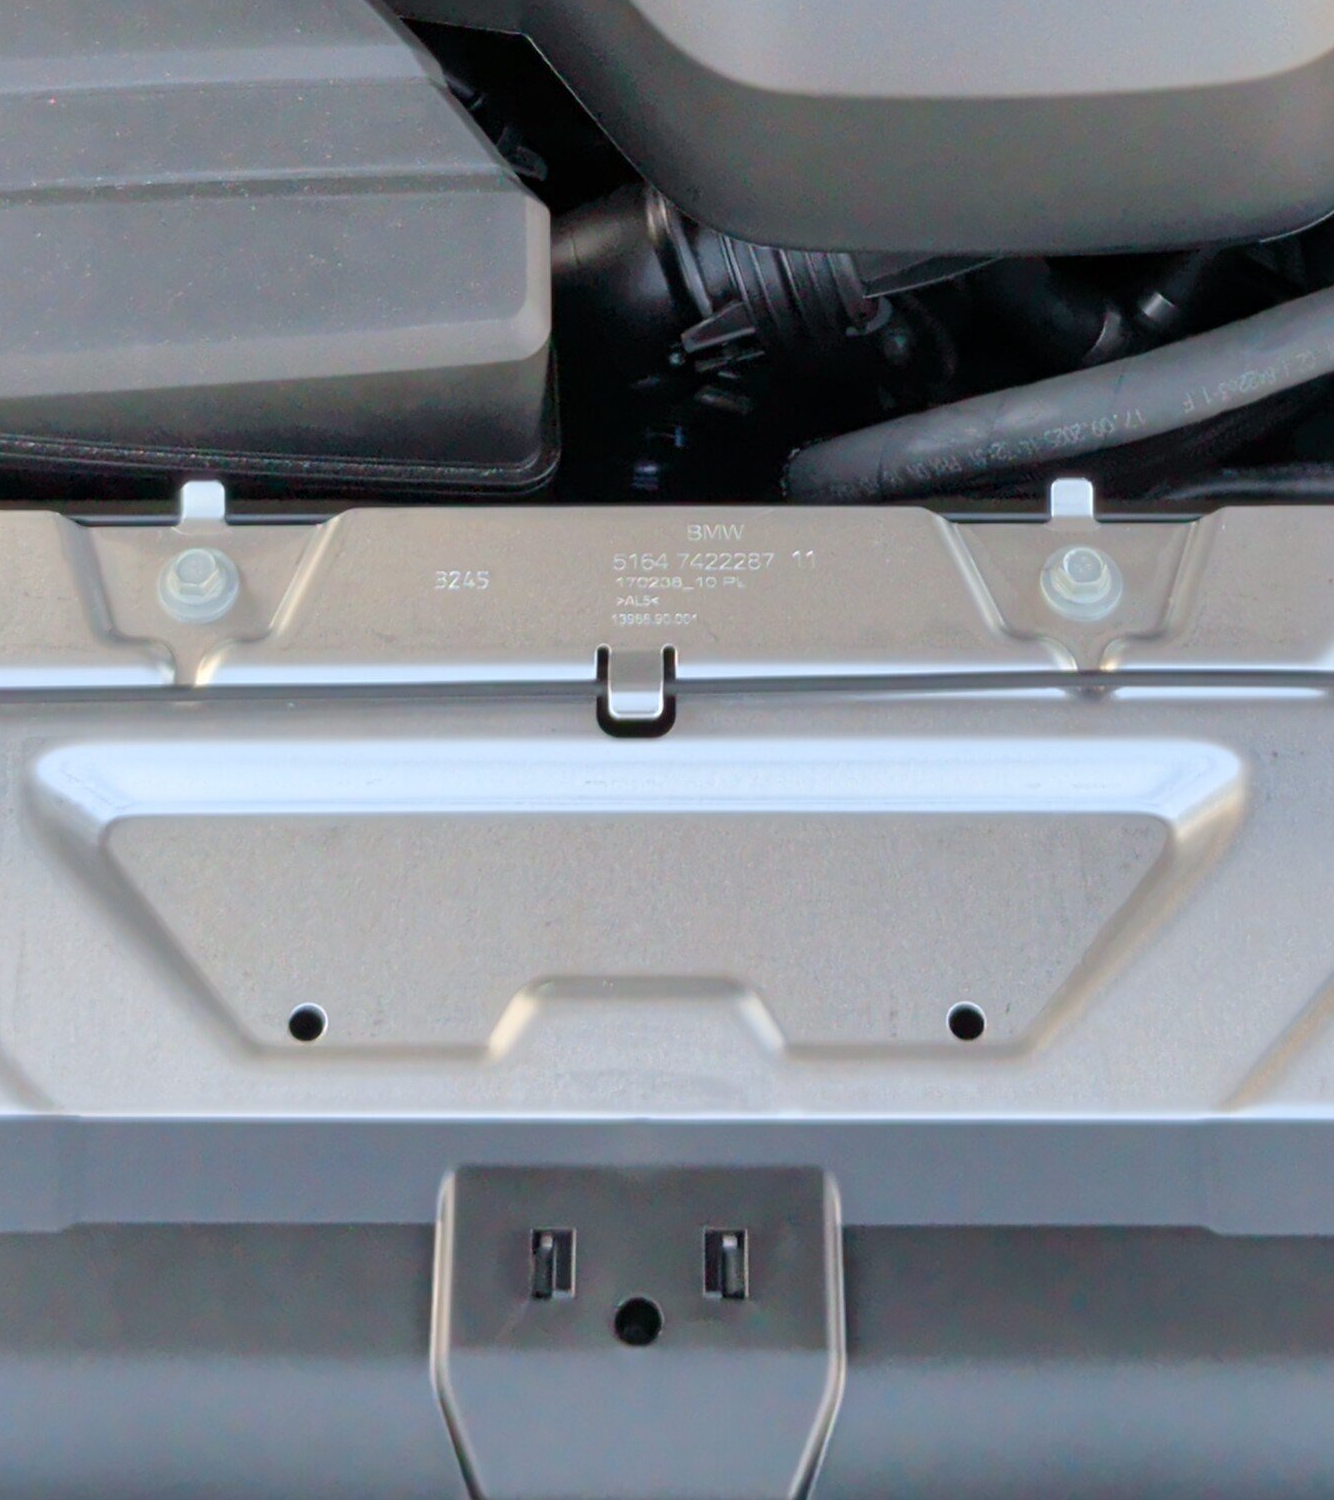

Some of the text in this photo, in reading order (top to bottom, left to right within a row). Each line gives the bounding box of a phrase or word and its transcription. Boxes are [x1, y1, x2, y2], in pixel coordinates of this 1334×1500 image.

[687, 523, 745, 541] BMW
[613, 550, 817, 571] 5164 7422287 11
[434, 570, 489, 590] 3245
